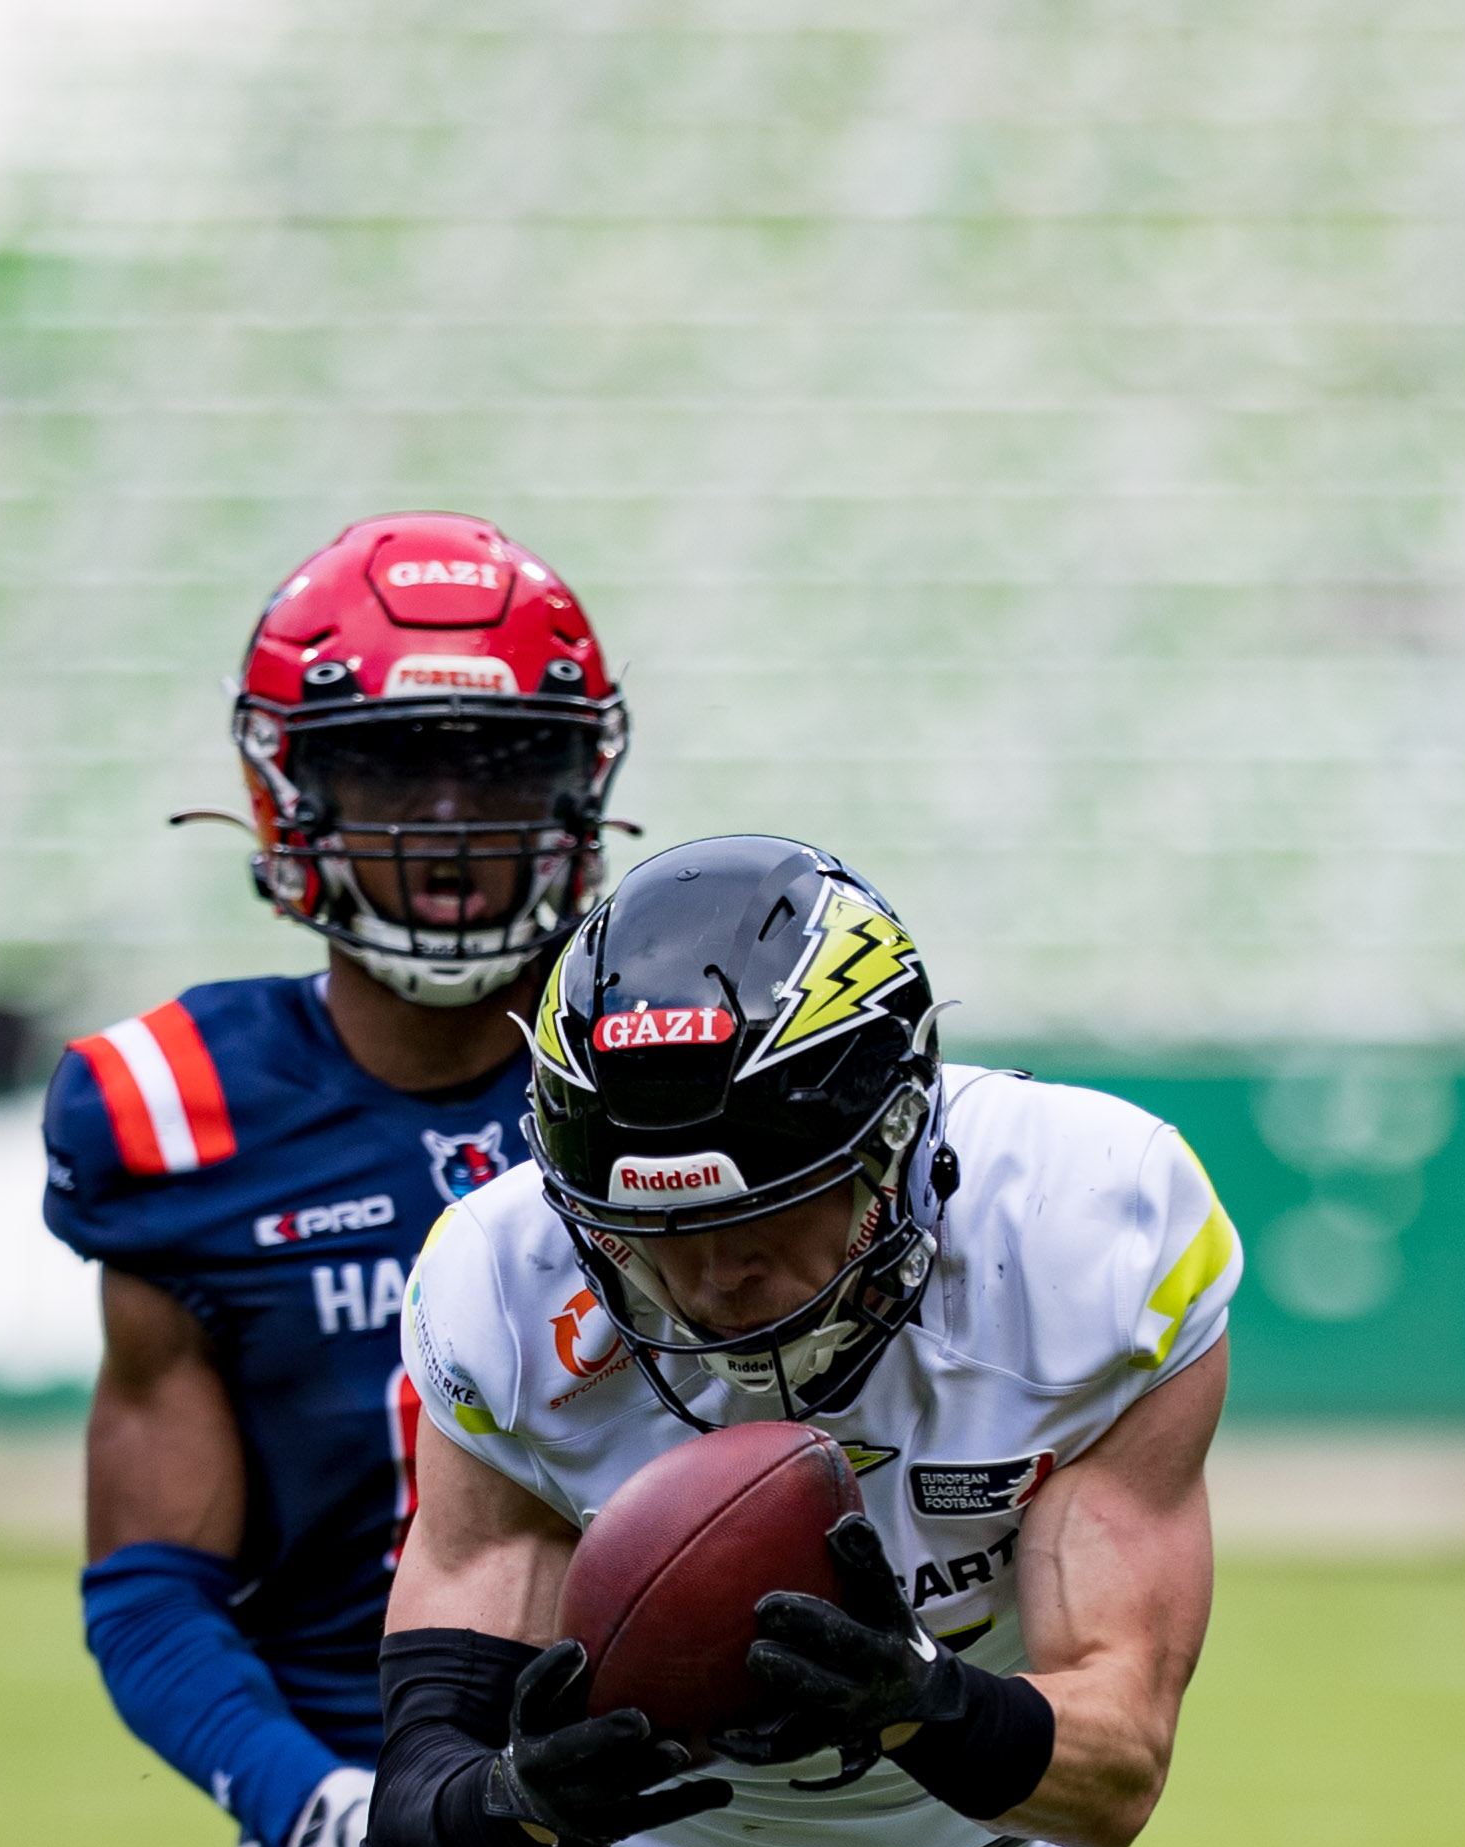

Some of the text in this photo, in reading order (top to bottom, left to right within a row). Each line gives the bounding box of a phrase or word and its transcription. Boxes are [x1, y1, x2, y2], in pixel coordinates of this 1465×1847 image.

[621, 1165, 721, 1191] Riddell
[311, 1257, 418, 1334] HA
[727, 1360, 777, 1373] Riddel
[920, 1473, 990, 1485] EUROPEAN
[922, 1486, 971, 1497] LEAGUE
[925, 1497, 992, 1509] FOOTBALL
